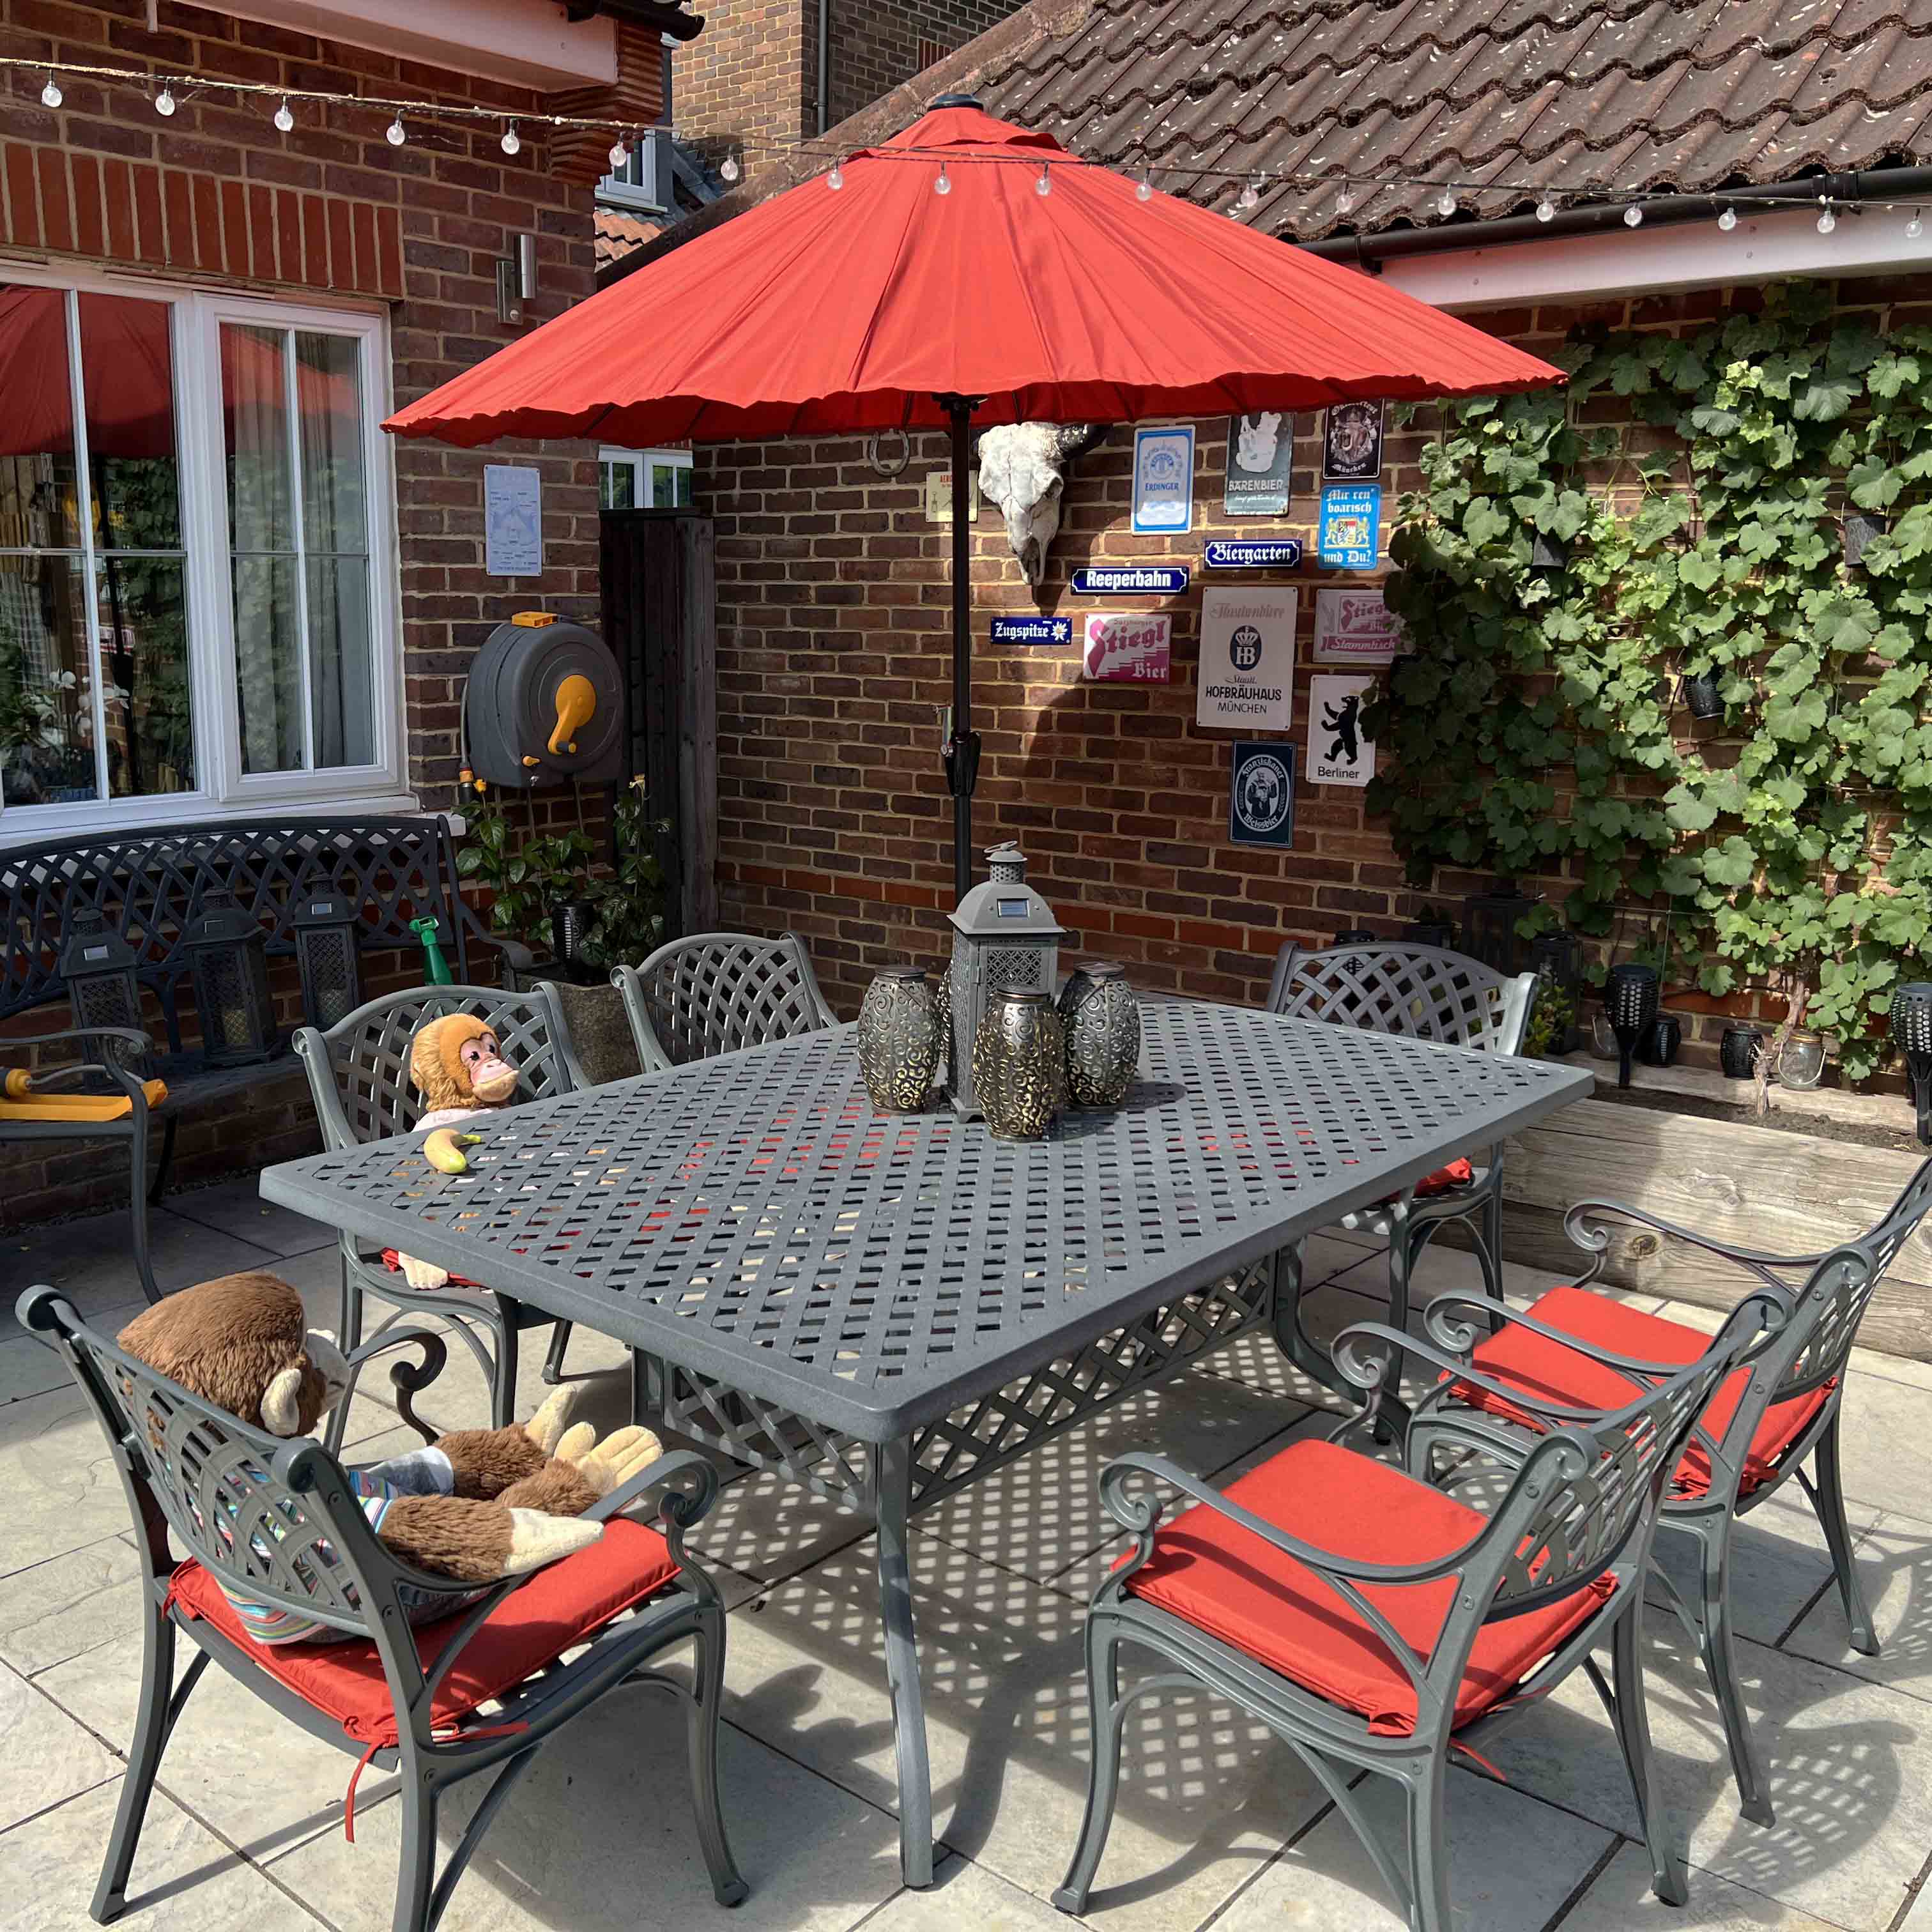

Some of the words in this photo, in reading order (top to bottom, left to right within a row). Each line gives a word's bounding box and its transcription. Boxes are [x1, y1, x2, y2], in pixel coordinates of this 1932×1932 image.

[1145, 482, 1179, 491] ERDINGER
[1326, 489, 1349, 501] Mir
[1328, 501, 1372, 514] boarisch
[1212, 544, 1291, 564] Biergarten
[1324, 552, 1343, 563] und
[1348, 550, 1372, 563] Du?
[1086, 570, 1171, 590] Reeperbahn
[1341, 599, 1383, 630] Stieg
[995, 622, 1048, 640] Zugspitze
[1087, 618, 1165, 677] Stiegl
[1236, 647, 1255, 665] HB
[1131, 662, 1166, 678] Bier
[1206, 684, 1282, 701] HOFBRÄUHAUS
[1217, 701, 1267, 714] MÜNCHEN
[1318, 766, 1360, 779] Berliner
[1243, 812, 1278, 829] Weissbier
